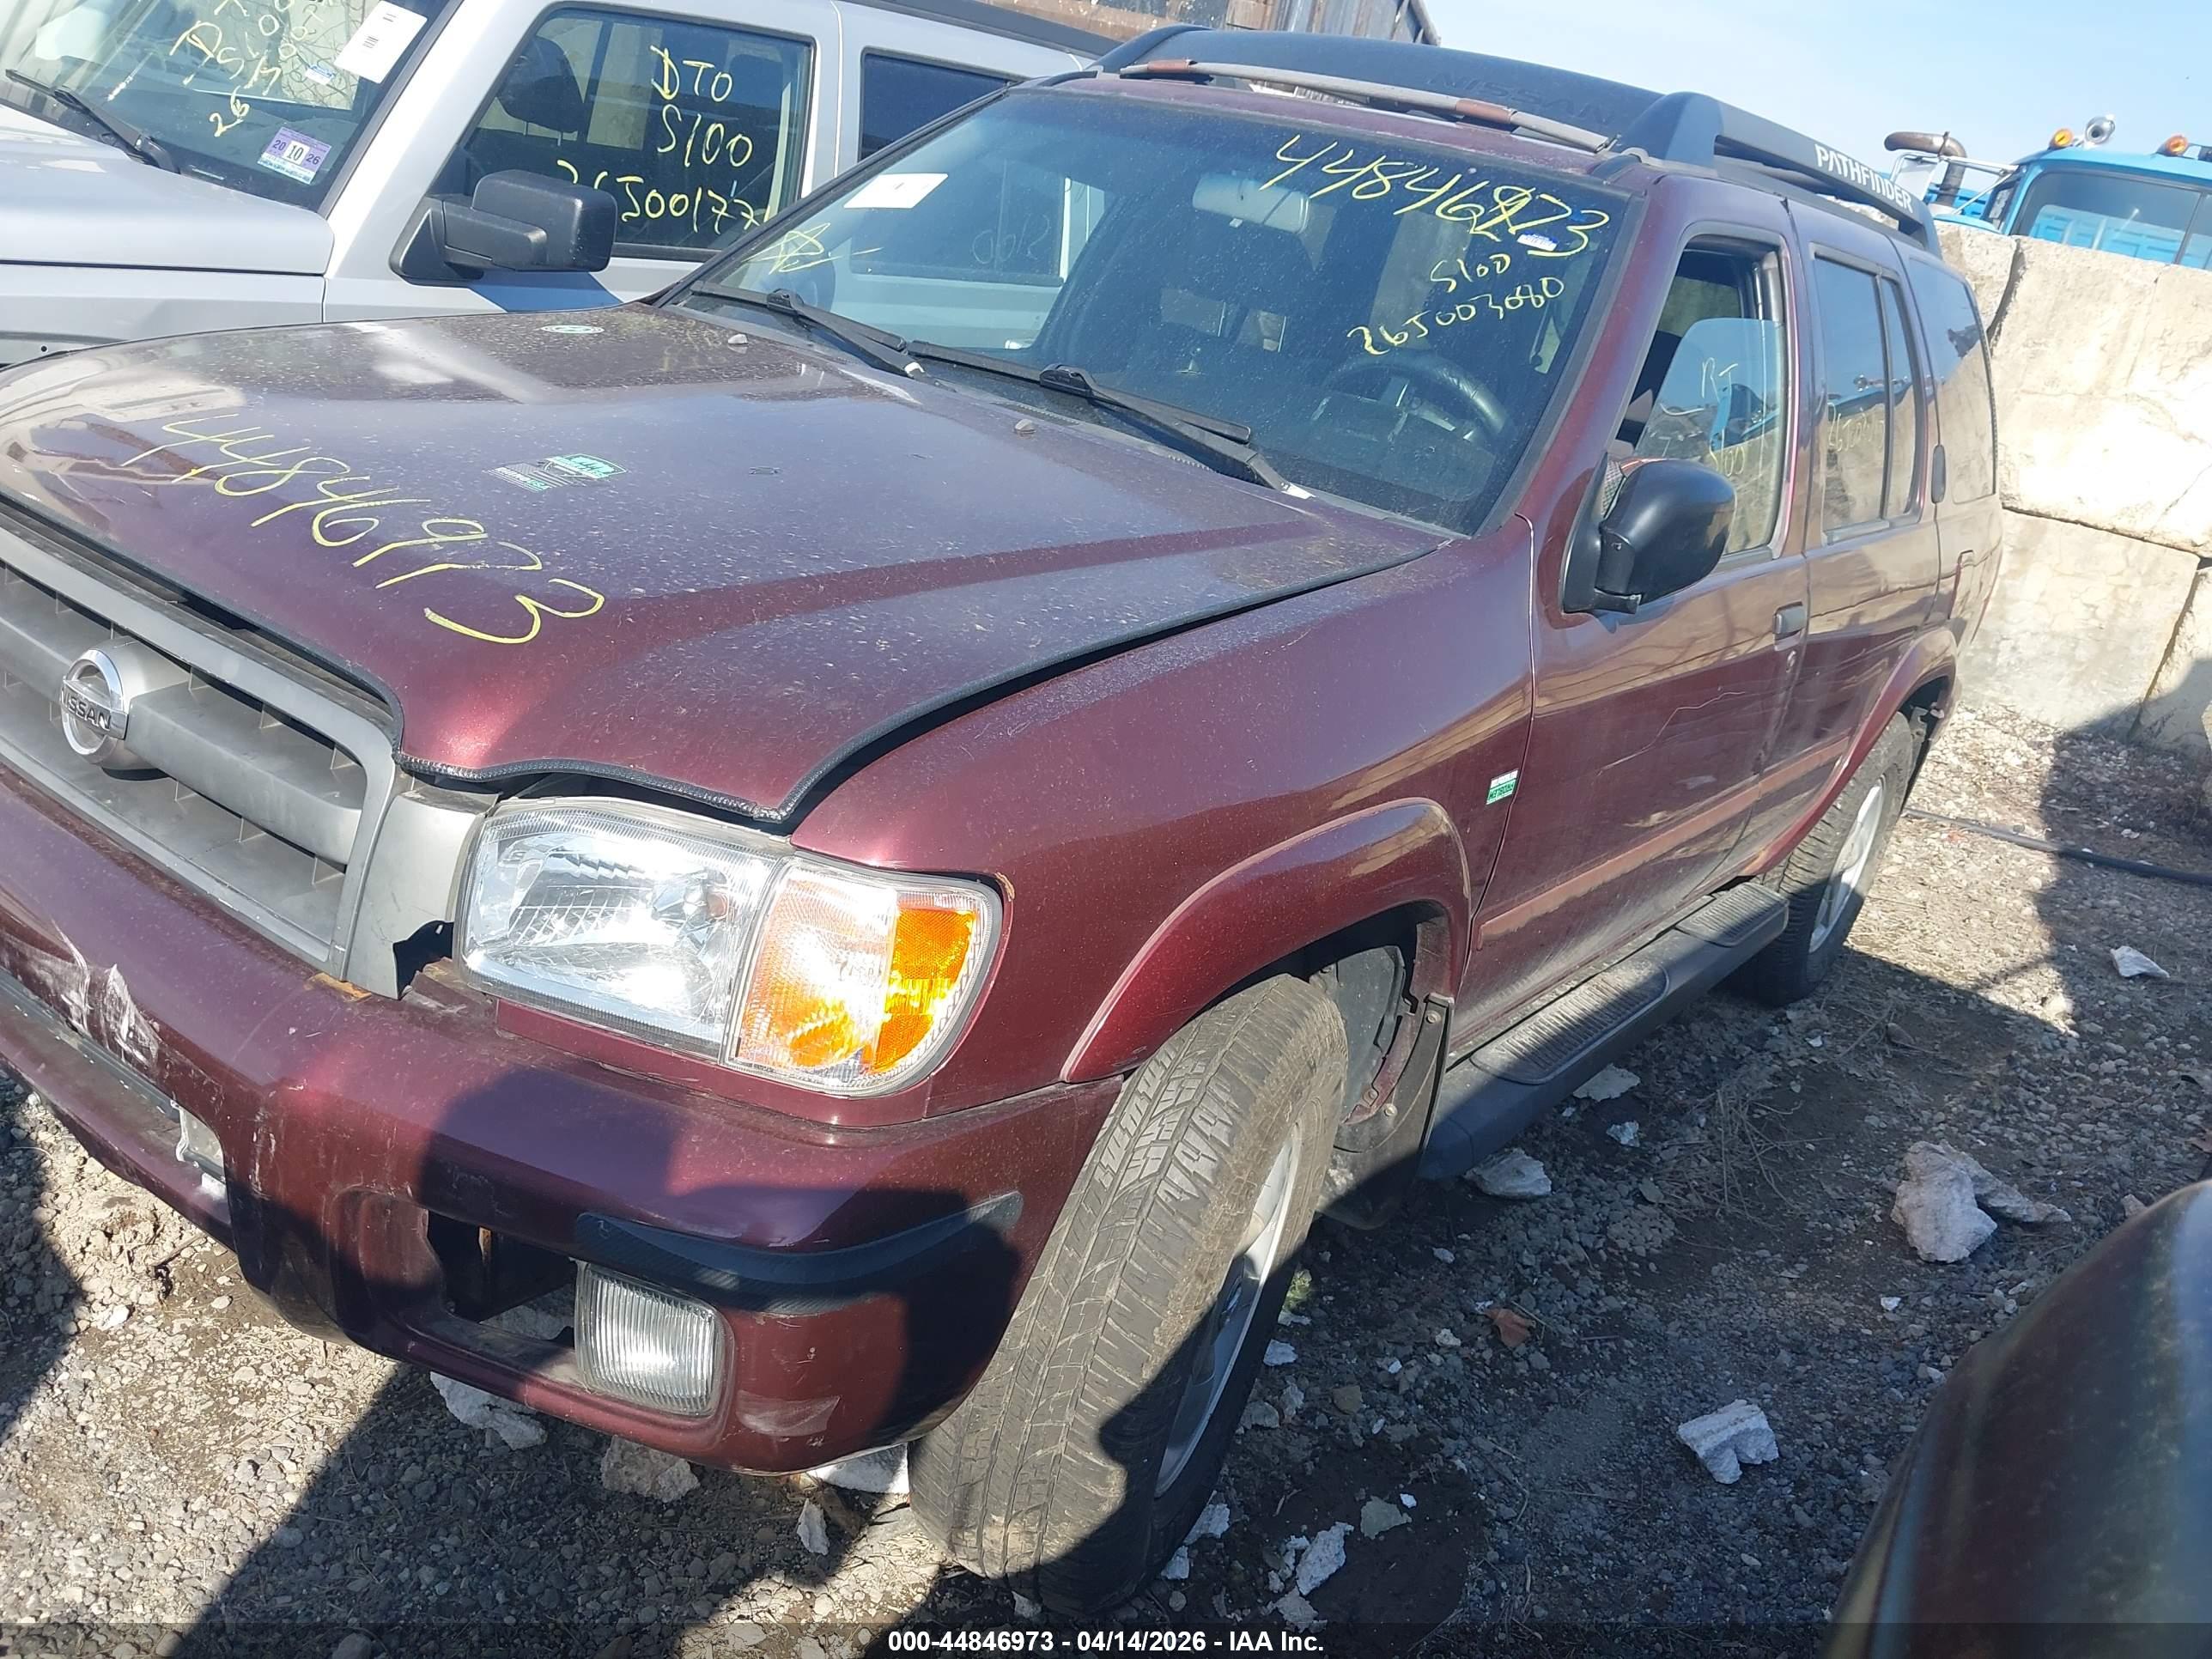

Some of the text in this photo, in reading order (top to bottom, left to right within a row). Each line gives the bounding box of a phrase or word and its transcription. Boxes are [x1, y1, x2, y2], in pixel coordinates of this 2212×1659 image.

[650, 44, 732, 101] DTO
[272, 139, 287, 151] 20
[286, 144, 305, 161] 10
[306, 153, 321, 165] 26
[1814, 143, 1913, 214] PATHFINDER
[121, 413, 605, 645] 44846973
[60, 686, 112, 732] NISSAN
